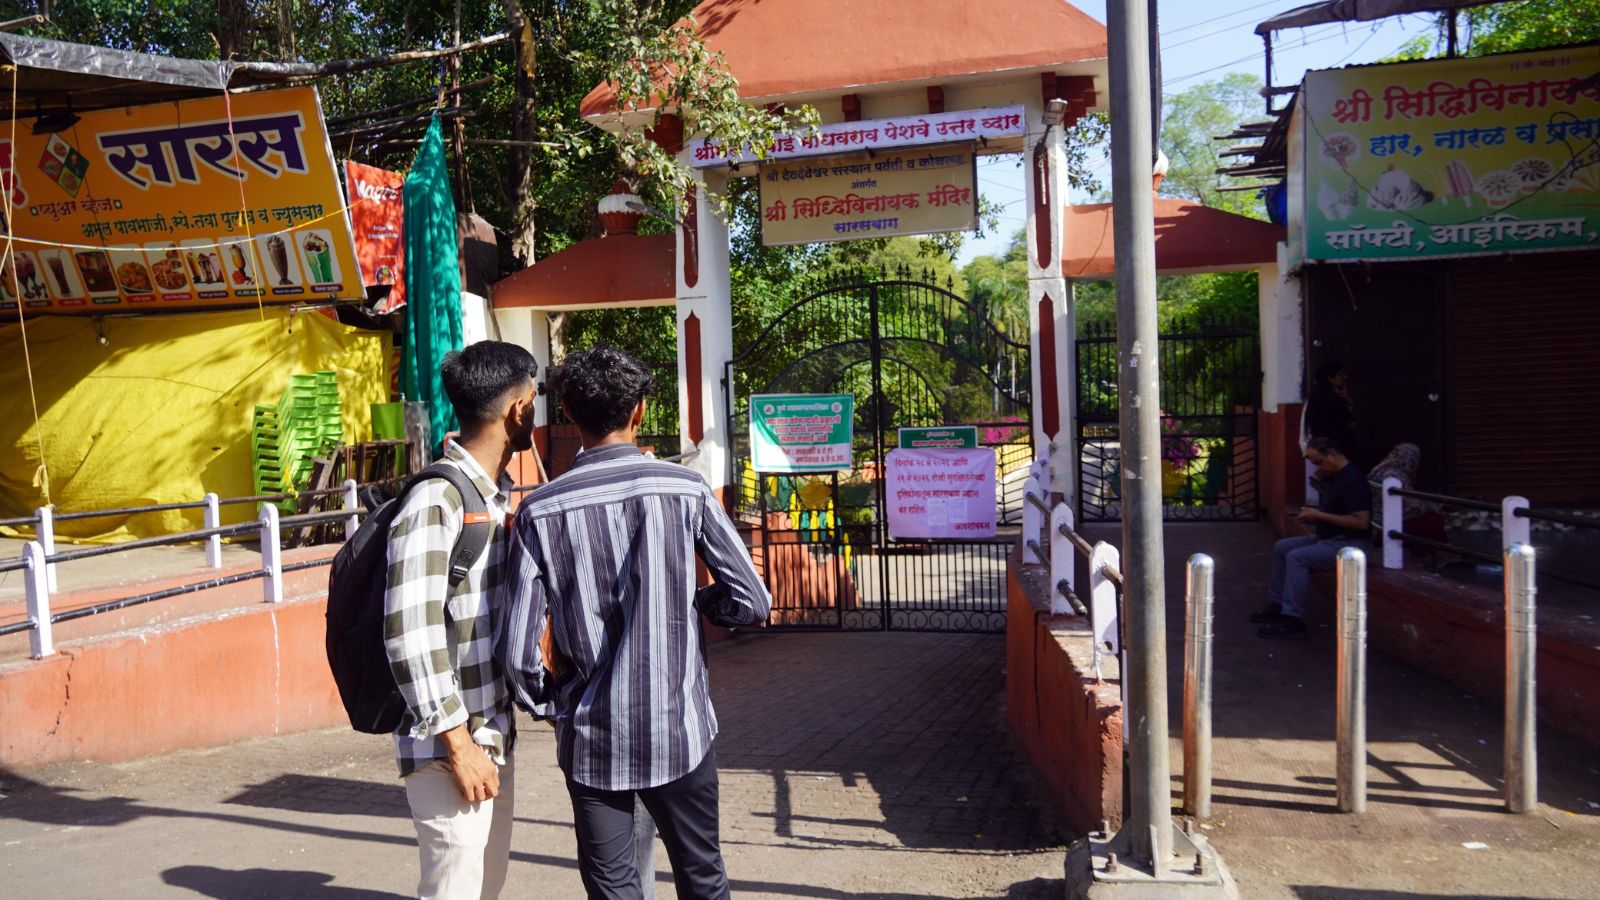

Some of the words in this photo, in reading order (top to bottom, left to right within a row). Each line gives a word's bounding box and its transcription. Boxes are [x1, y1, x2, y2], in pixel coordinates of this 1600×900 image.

[1332, 90, 1373, 123] श्री
[884, 119, 930, 139] पेशवे
[936, 117, 977, 136] उत्तर
[1370, 133, 1422, 156] हार,
[1434, 126, 1506, 149] नारळ
[1515, 124, 1538, 144] व
[100, 114, 304, 188] सारस
[257, 209, 269, 223] व
[764, 200, 786, 222] श्री
[927, 184, 971, 207] मंदिर
[834, 217, 899, 234] सारसबाग
